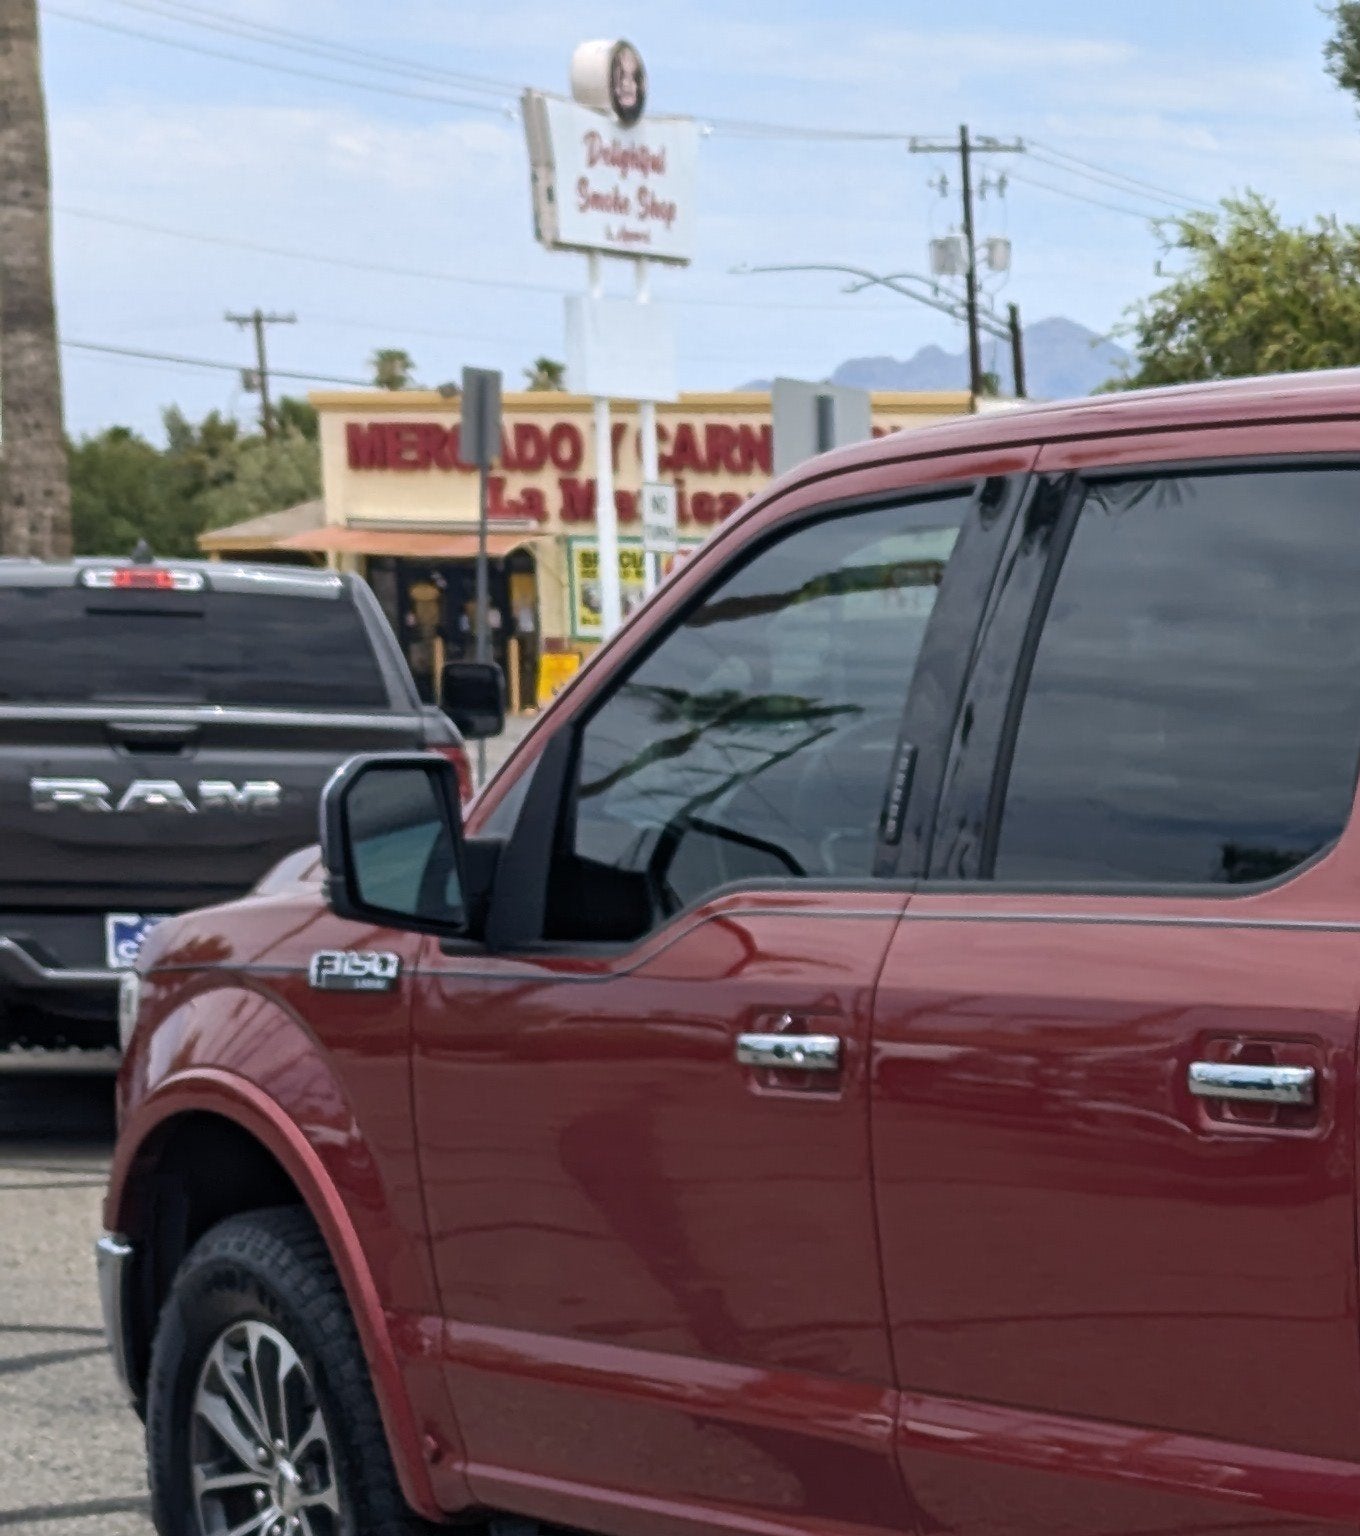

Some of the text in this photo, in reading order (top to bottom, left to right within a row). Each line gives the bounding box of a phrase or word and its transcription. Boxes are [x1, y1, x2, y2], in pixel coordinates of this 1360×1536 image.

[577, 176, 677, 230] Smoke Shop
[637, 423, 774, 474] CARN
[30, 776, 281, 813] RAM
